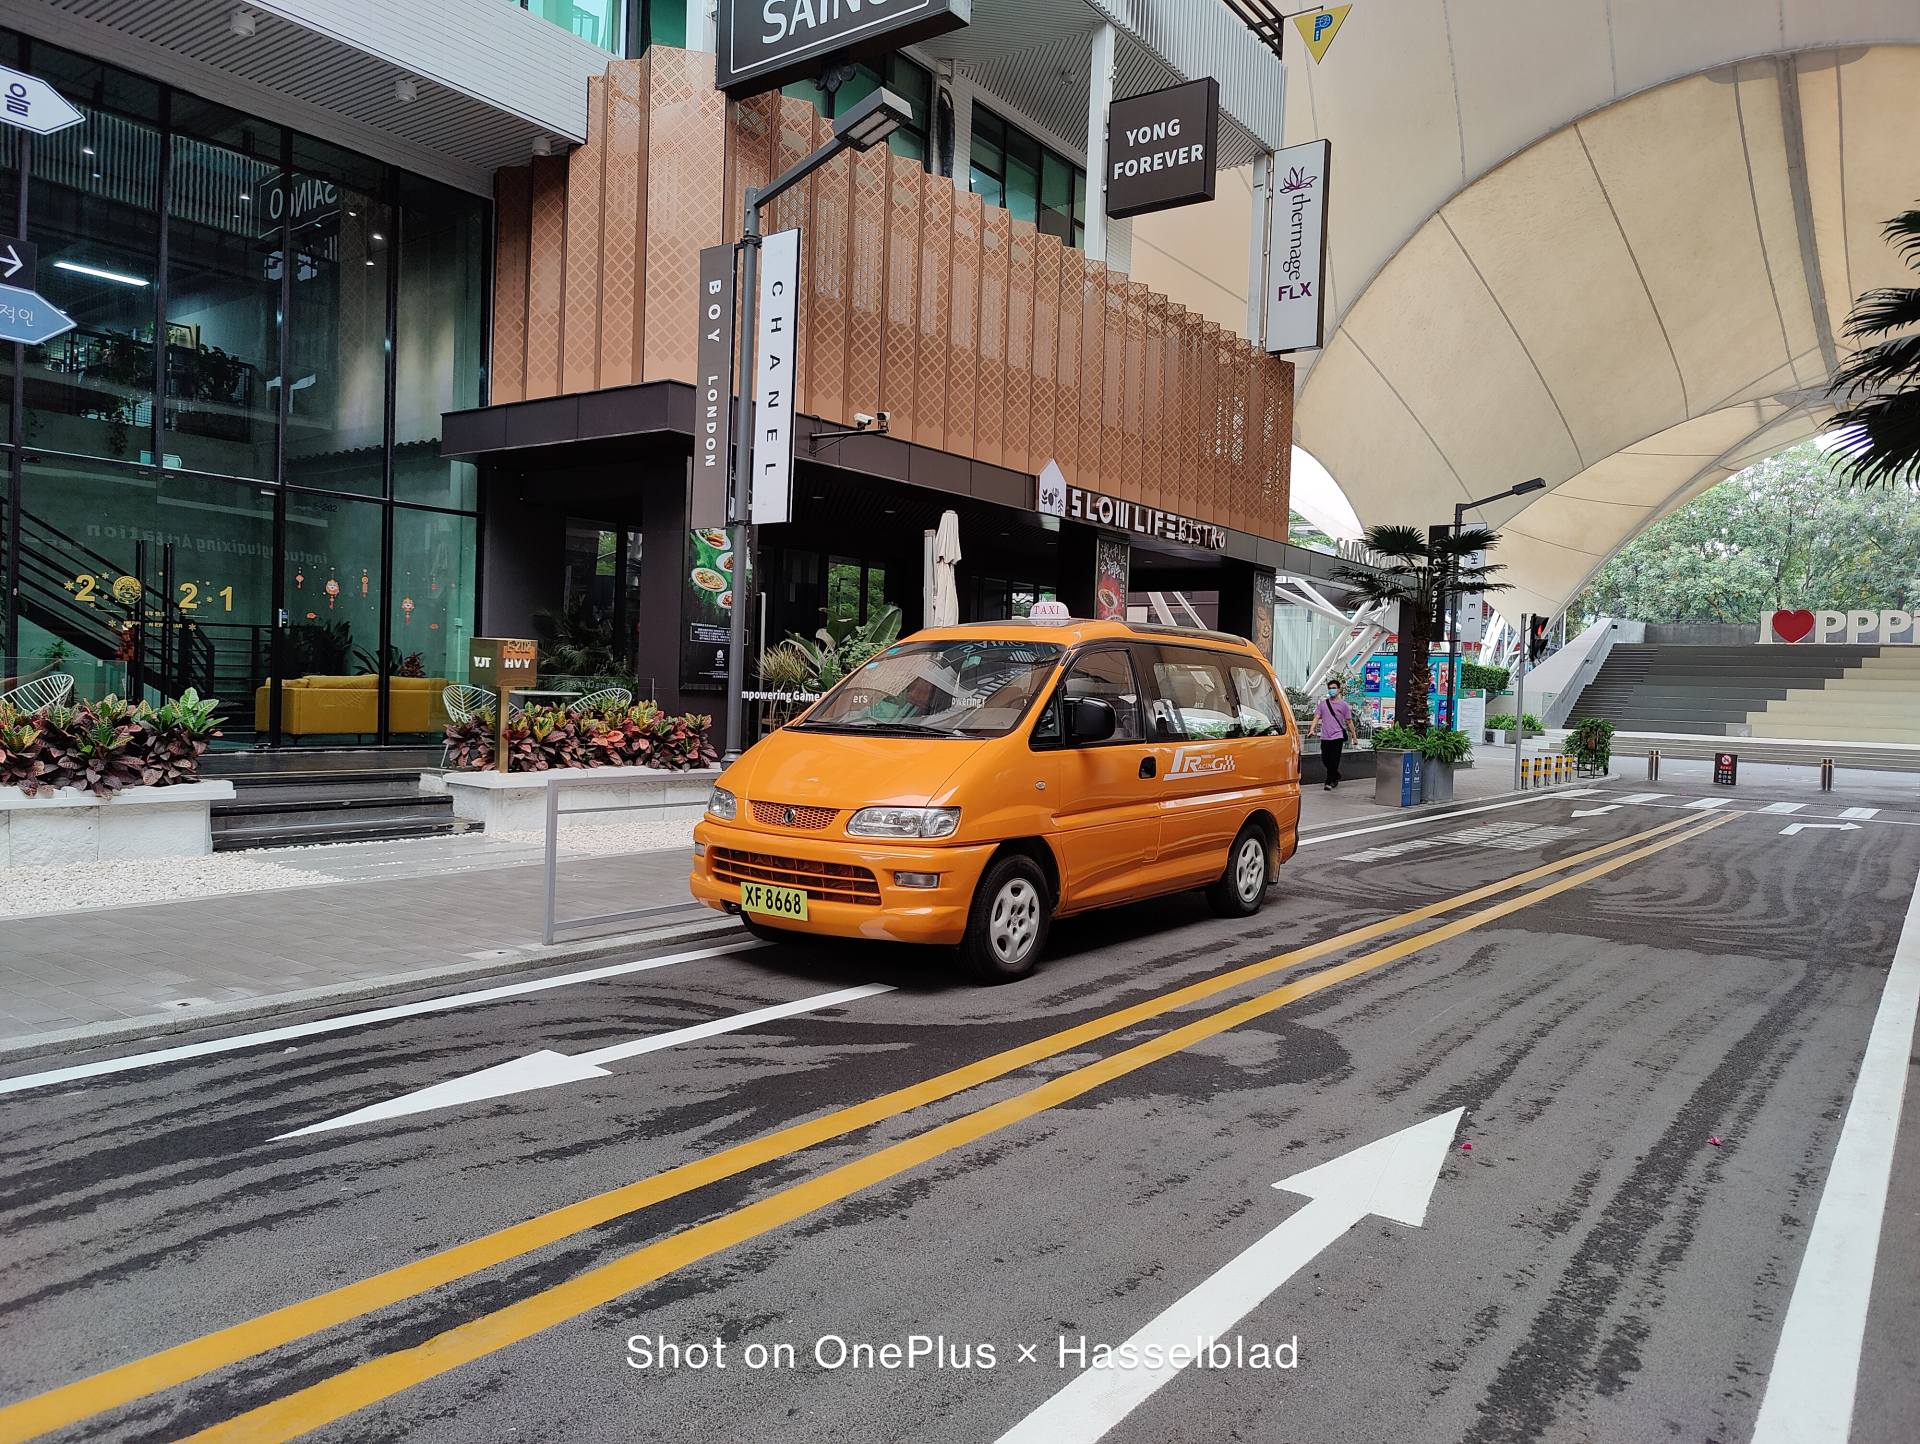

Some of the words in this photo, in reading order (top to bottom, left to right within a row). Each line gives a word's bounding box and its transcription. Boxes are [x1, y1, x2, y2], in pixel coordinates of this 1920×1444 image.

[1126, 118, 1180, 147] YONG
[1113, 143, 1204, 180] FOREVER
[1282, 193, 1312, 281] thermage
[1278, 281, 1313, 302] FLX
[707, 279, 722, 343] BOY
[764, 280, 784, 476] CHANEL
[704, 375, 720, 467] LONDON
[1034, 605, 1060, 615] TAXI
[1814, 610, 1920, 645] PPP
[473, 656, 492, 668] YJT
[504, 658, 532, 669] HVY
[792, 690, 820, 702] Game
